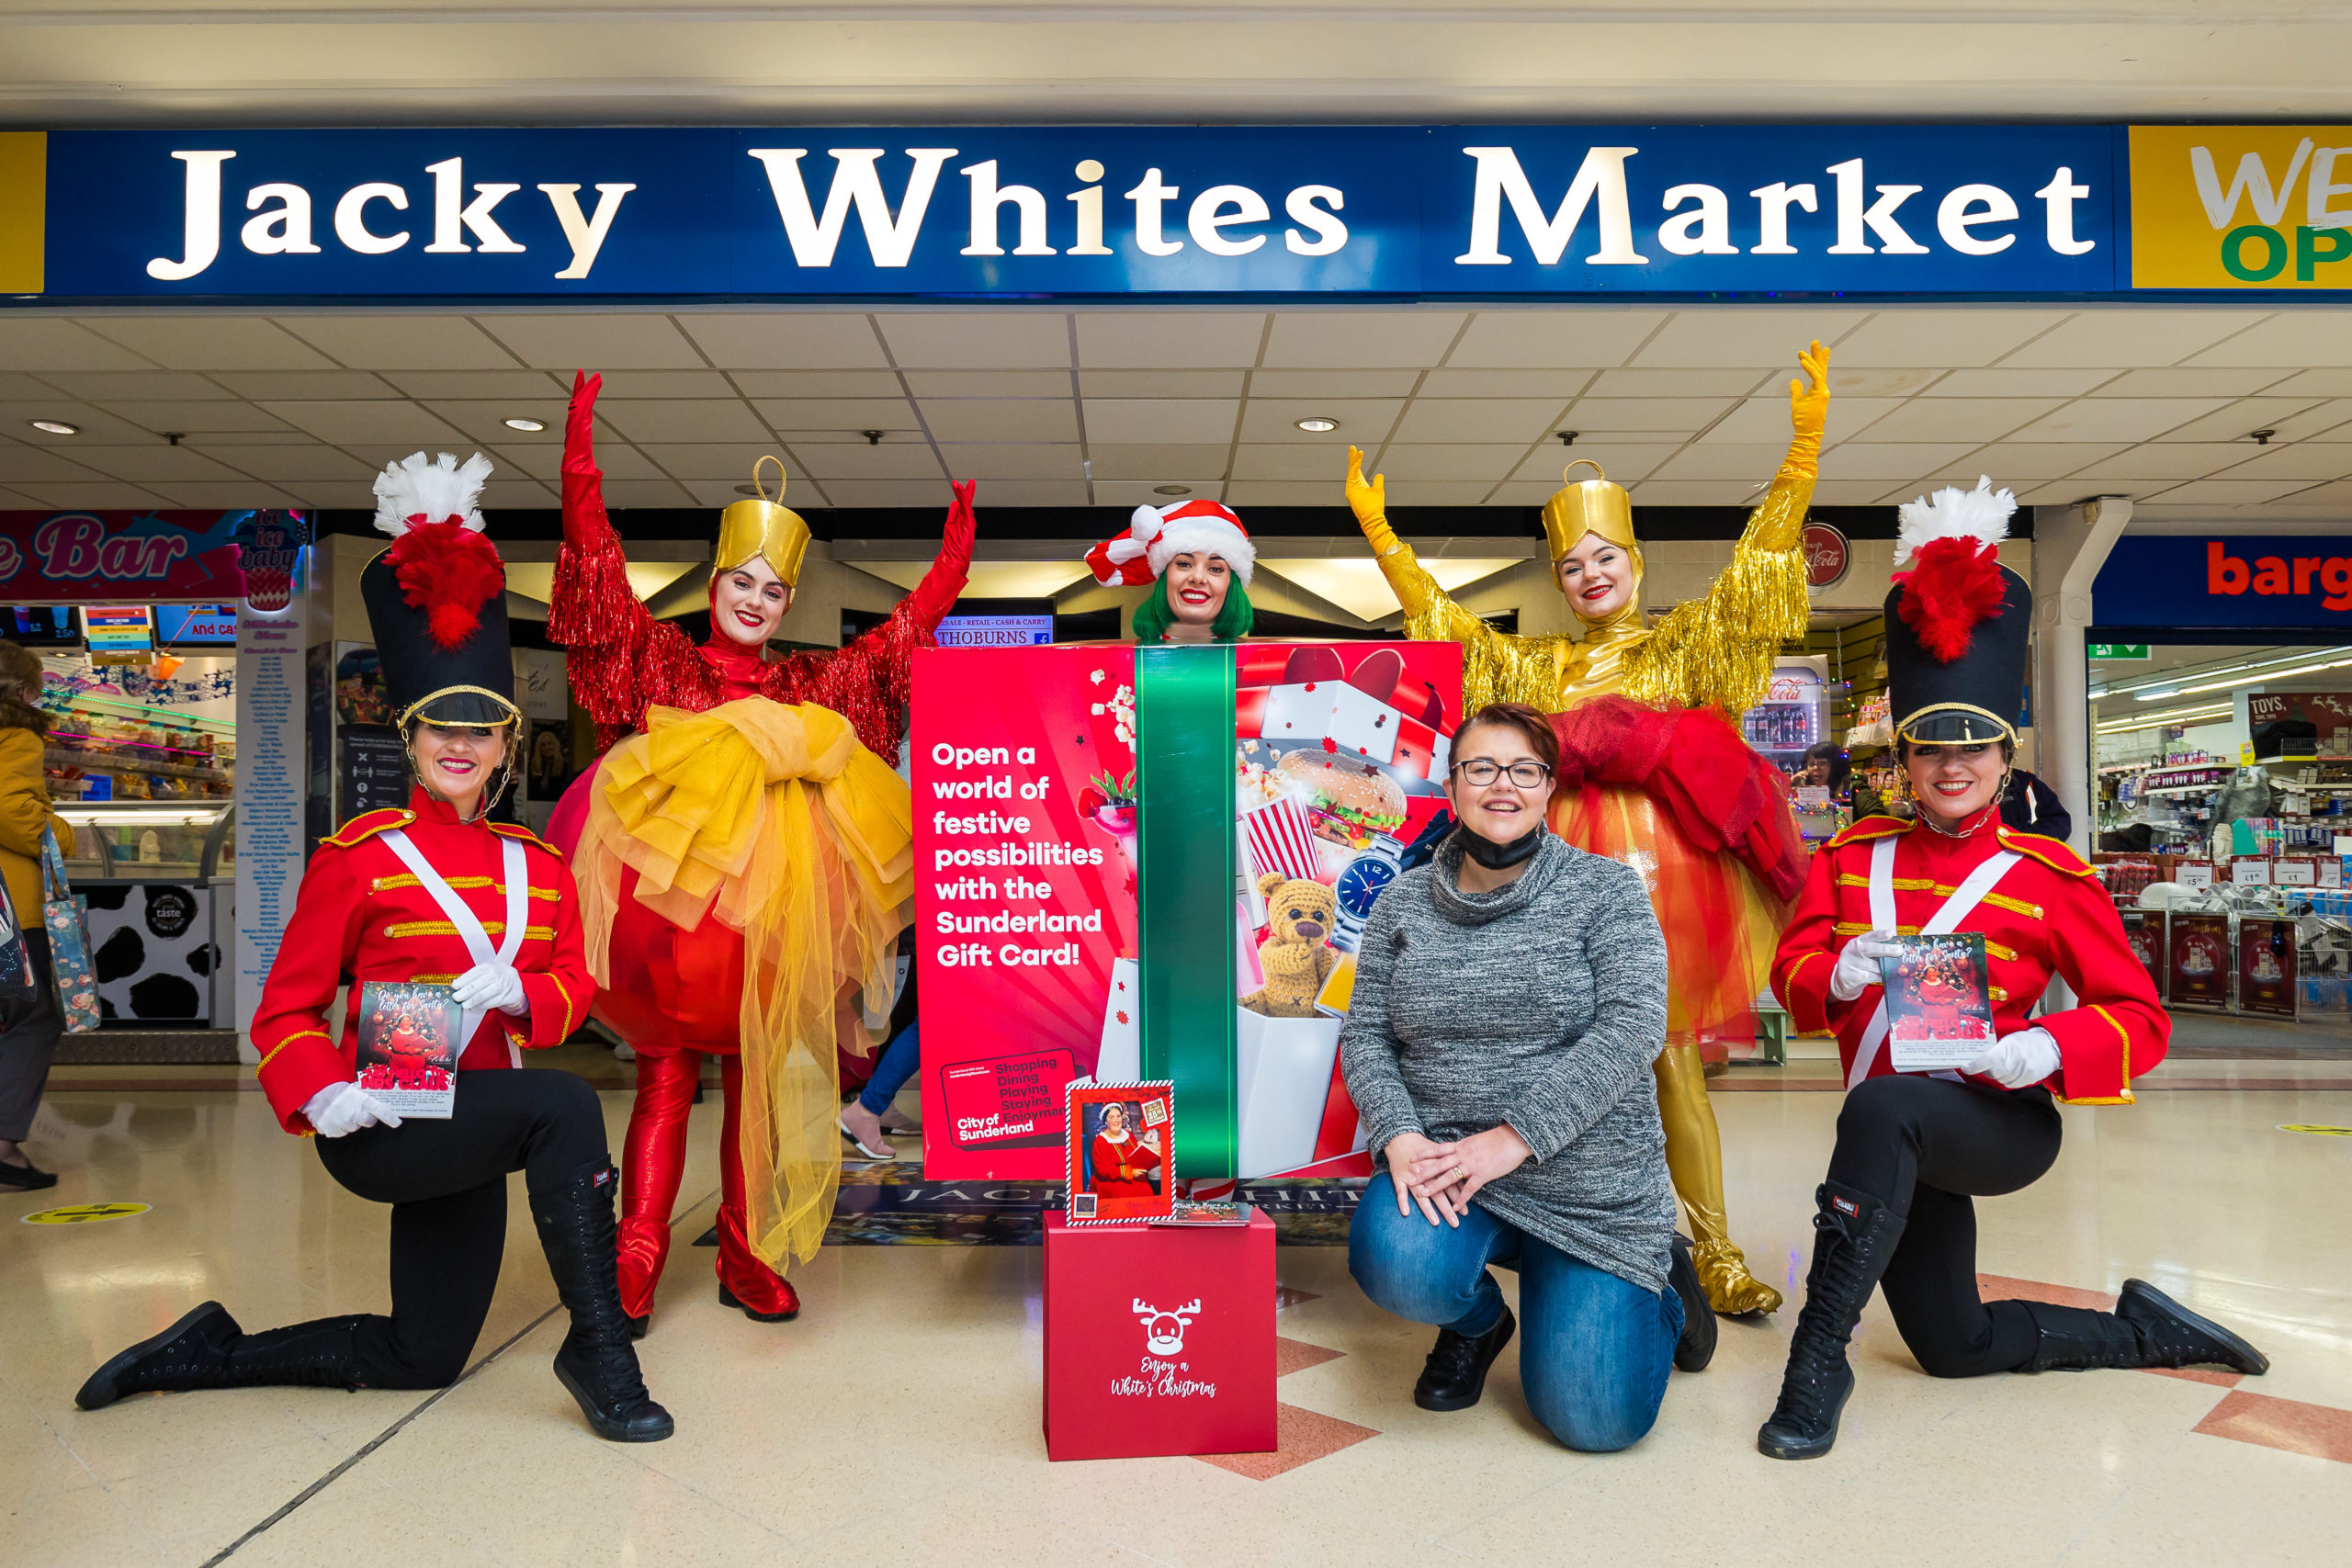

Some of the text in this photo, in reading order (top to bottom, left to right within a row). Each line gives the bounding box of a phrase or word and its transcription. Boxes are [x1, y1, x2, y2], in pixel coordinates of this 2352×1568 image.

[147, 147, 2096, 280] Jacky Whites Market
[35, 514, 187, 578] Bar
[256, 526, 284, 547] ice
[238, 546, 295, 573] baby
[2208, 543, 2352, 612] barg
[193, 623, 215, 635] And
[938, 630, 1027, 645] THOBURNS
[2250, 696, 2287, 714] TOYS,
[932, 742, 1035, 770] Open a
[933, 775, 1050, 800] world of
[933, 810, 1031, 835] festive
[935, 841, 1103, 872] possibilities
[1372, 865, 1382, 874] 12
[935, 875, 1052, 900] with the
[936, 908, 1102, 933] Sunderland
[937, 942, 1080, 967] Gift Card!
[378, 989, 391, 1001] Do
[393, 991, 411, 1007] you
[402, 1000, 415, 1015] for
[417, 998, 450, 1011] Santa?
[995, 1057, 1057, 1075] Shopping
[398, 1077, 449, 1091] CLAUS
[998, 1073, 1039, 1087] Dining
[1000, 1085, 1048, 1100] Playing
[1001, 1096, 1052, 1111] Staying
[957, 1112, 1000, 1130] City of
[1003, 1106, 1066, 1123] Enjoymen
[959, 1120, 1035, 1141] Sunderland
[899, 1190, 1066, 1202] JACK
[1140, 1356, 1190, 1382] Enjoy a
[1111, 1375, 1217, 1398] White's Christmas
